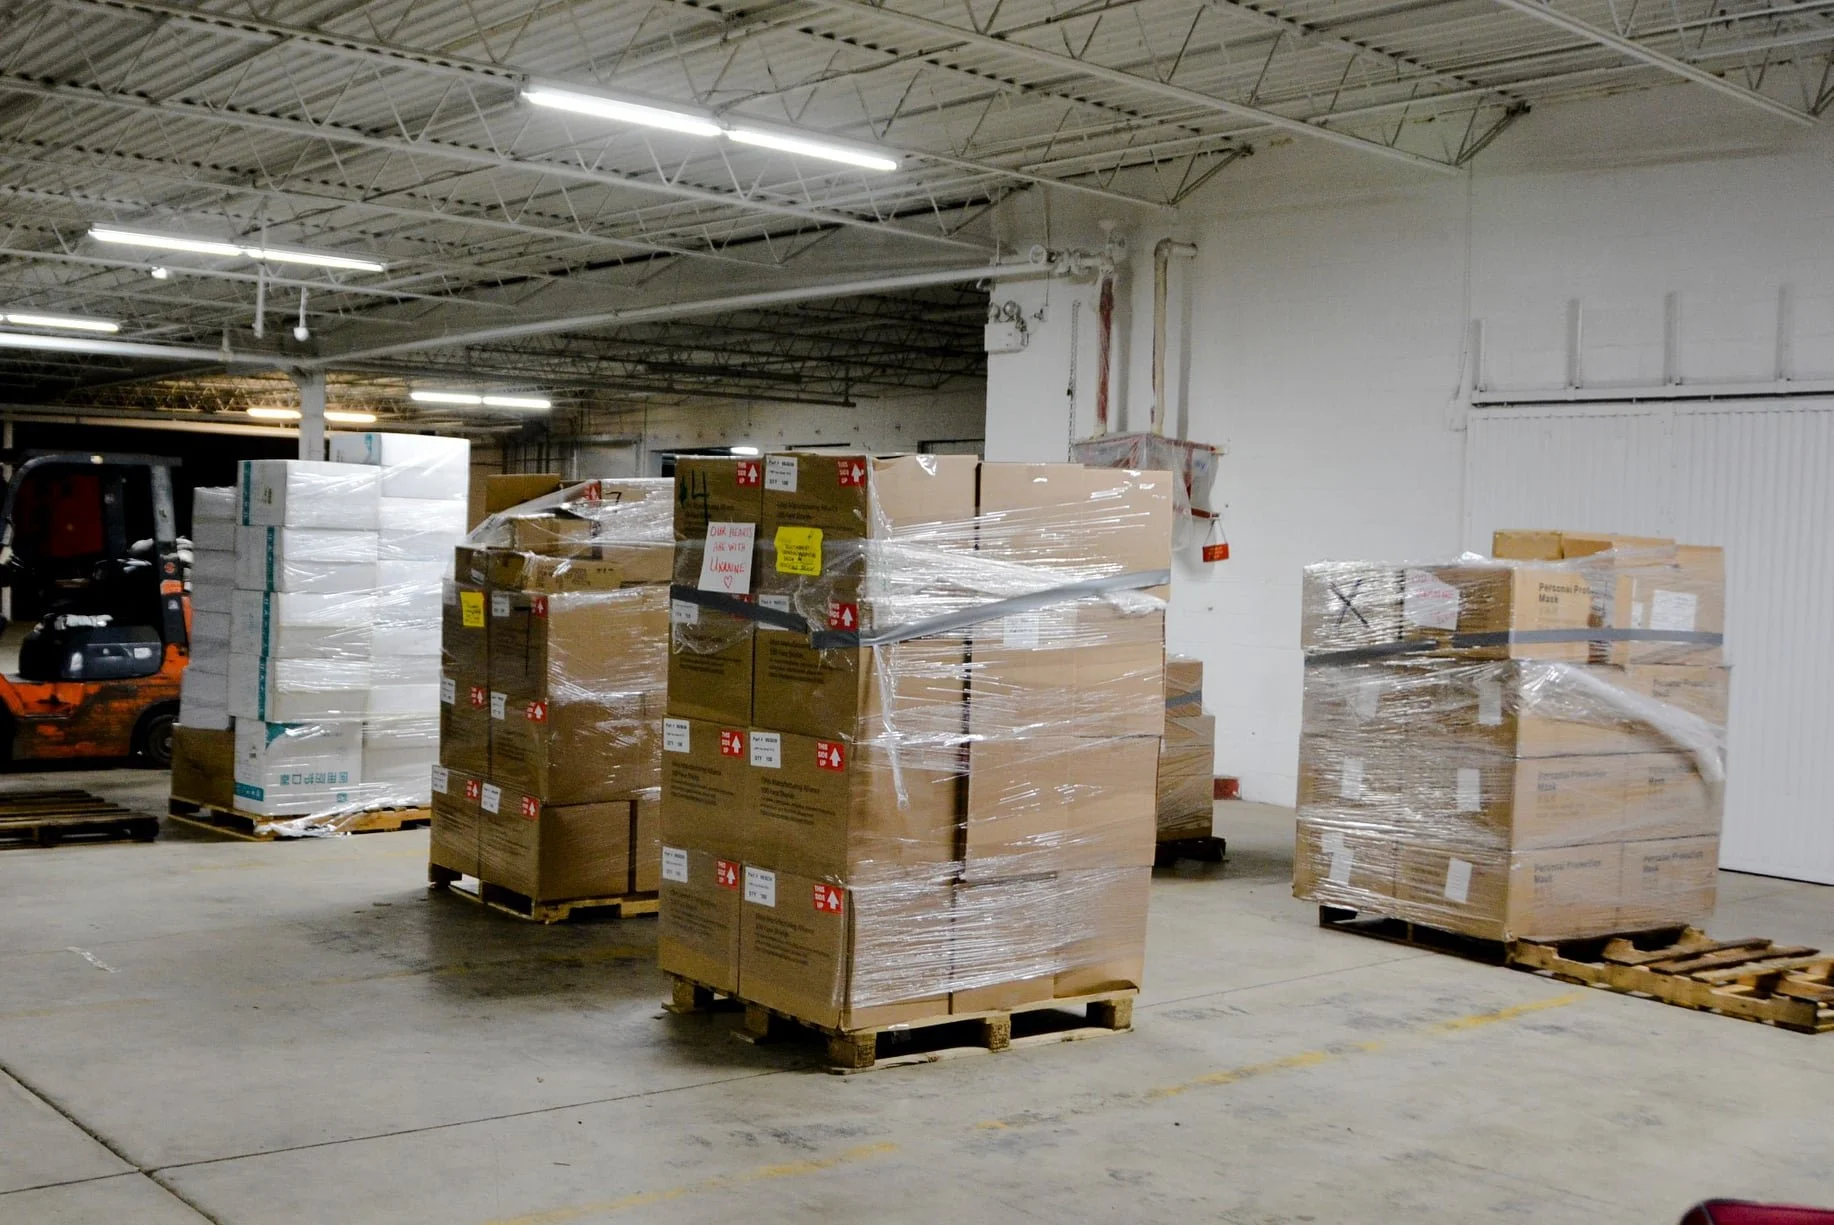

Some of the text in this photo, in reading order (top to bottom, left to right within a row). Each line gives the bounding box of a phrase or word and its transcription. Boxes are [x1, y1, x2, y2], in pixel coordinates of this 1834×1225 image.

[710, 526, 753, 538] OUR HEARTS
[712, 542, 746, 552] ARE WITH
[710, 556, 744, 574] UKRAINE
[1538, 582, 1572, 594] Personal
[1538, 594, 1558, 604] Mask
